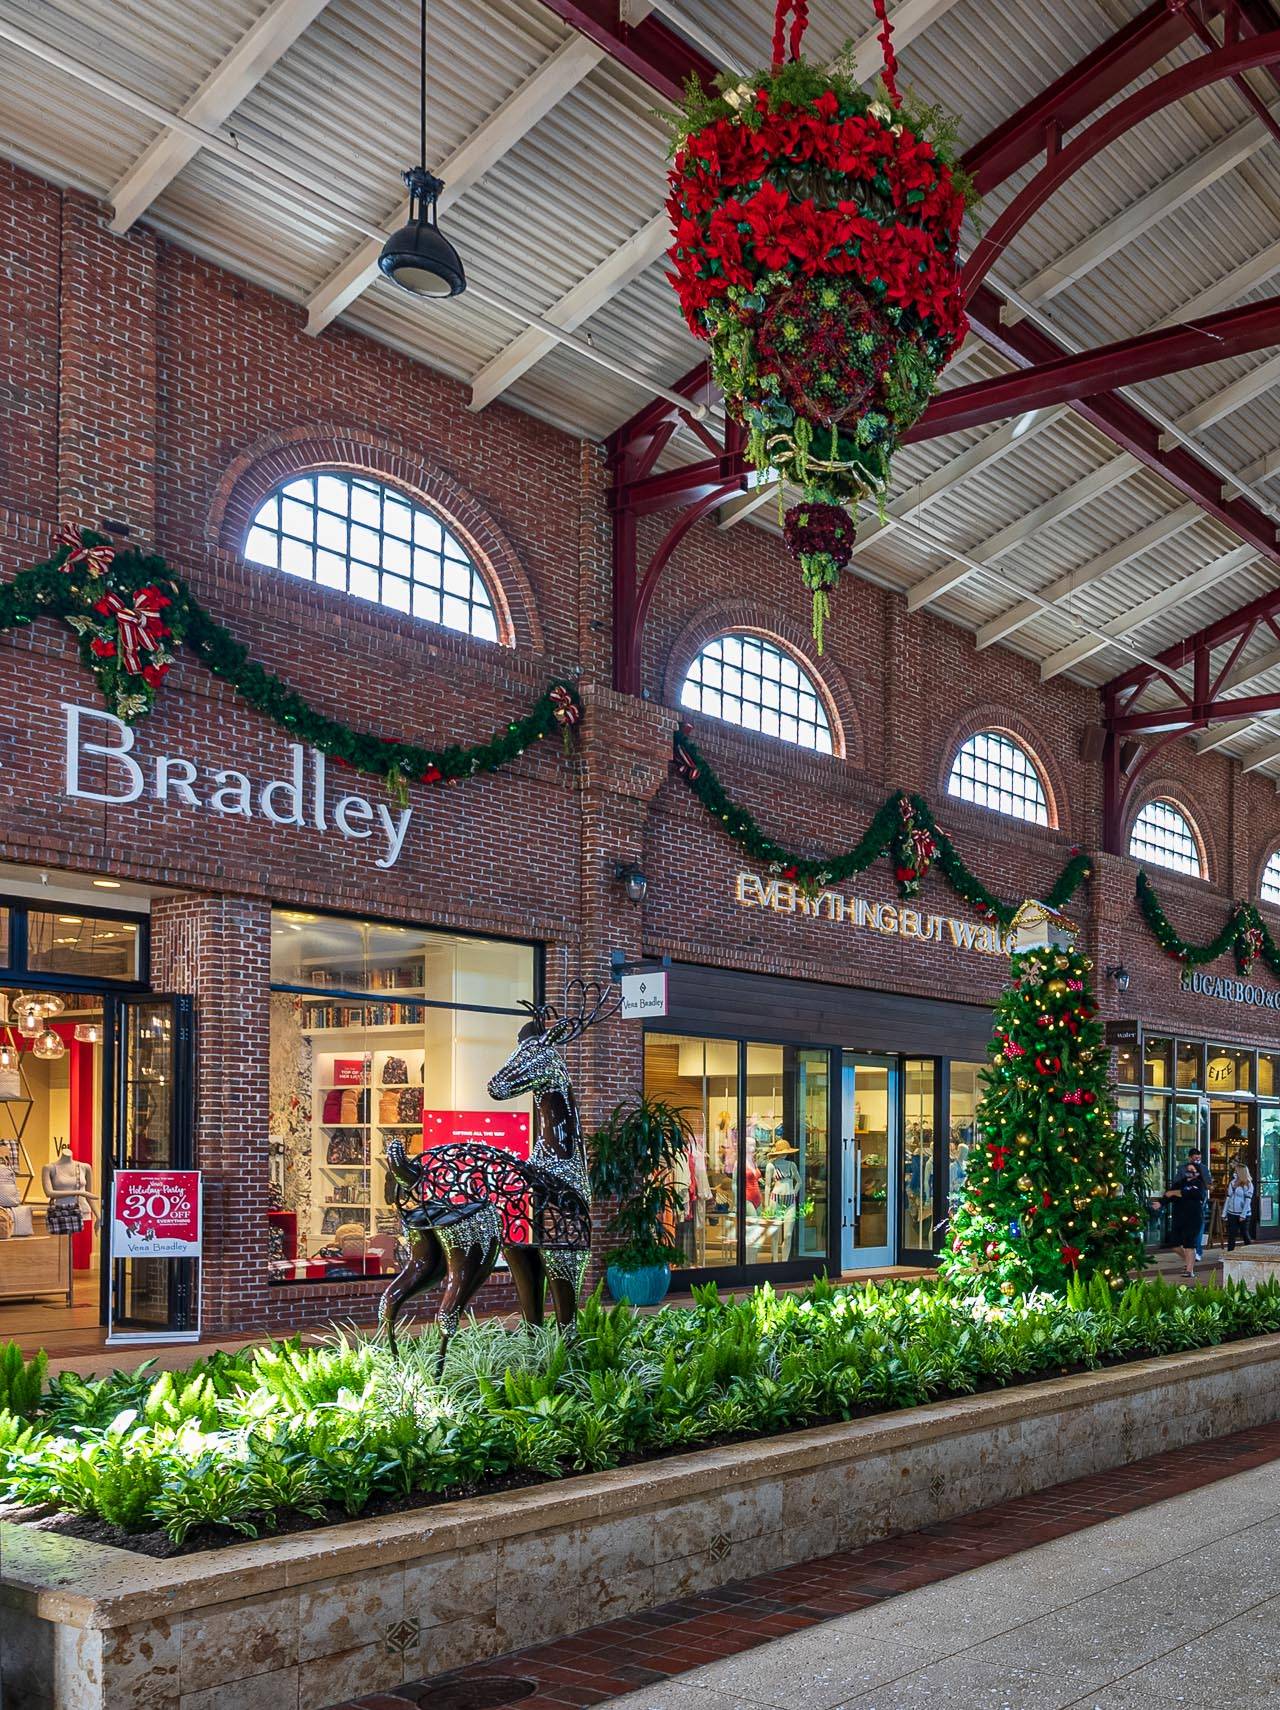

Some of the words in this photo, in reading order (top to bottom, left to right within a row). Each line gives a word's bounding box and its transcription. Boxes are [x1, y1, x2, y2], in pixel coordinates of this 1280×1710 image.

[61, 702, 412, 868] Bradley
[737, 872, 898, 933] EVERYTHING
[900, 908, 951, 941] BUT
[949, 916, 1016, 957] wate
[622, 999, 638, 1010] Vera
[639, 996, 664, 1009] Bradley
[54, 1136, 71, 1157] Ve
[128, 1185, 161, 1197] Holiday
[162, 1184, 187, 1197] Party
[122, 1194, 191, 1219] 30%
[170, 1211, 191, 1219] OFF
[128, 1243, 150, 1252] Vera
[153, 1241, 188, 1252] Bradley
